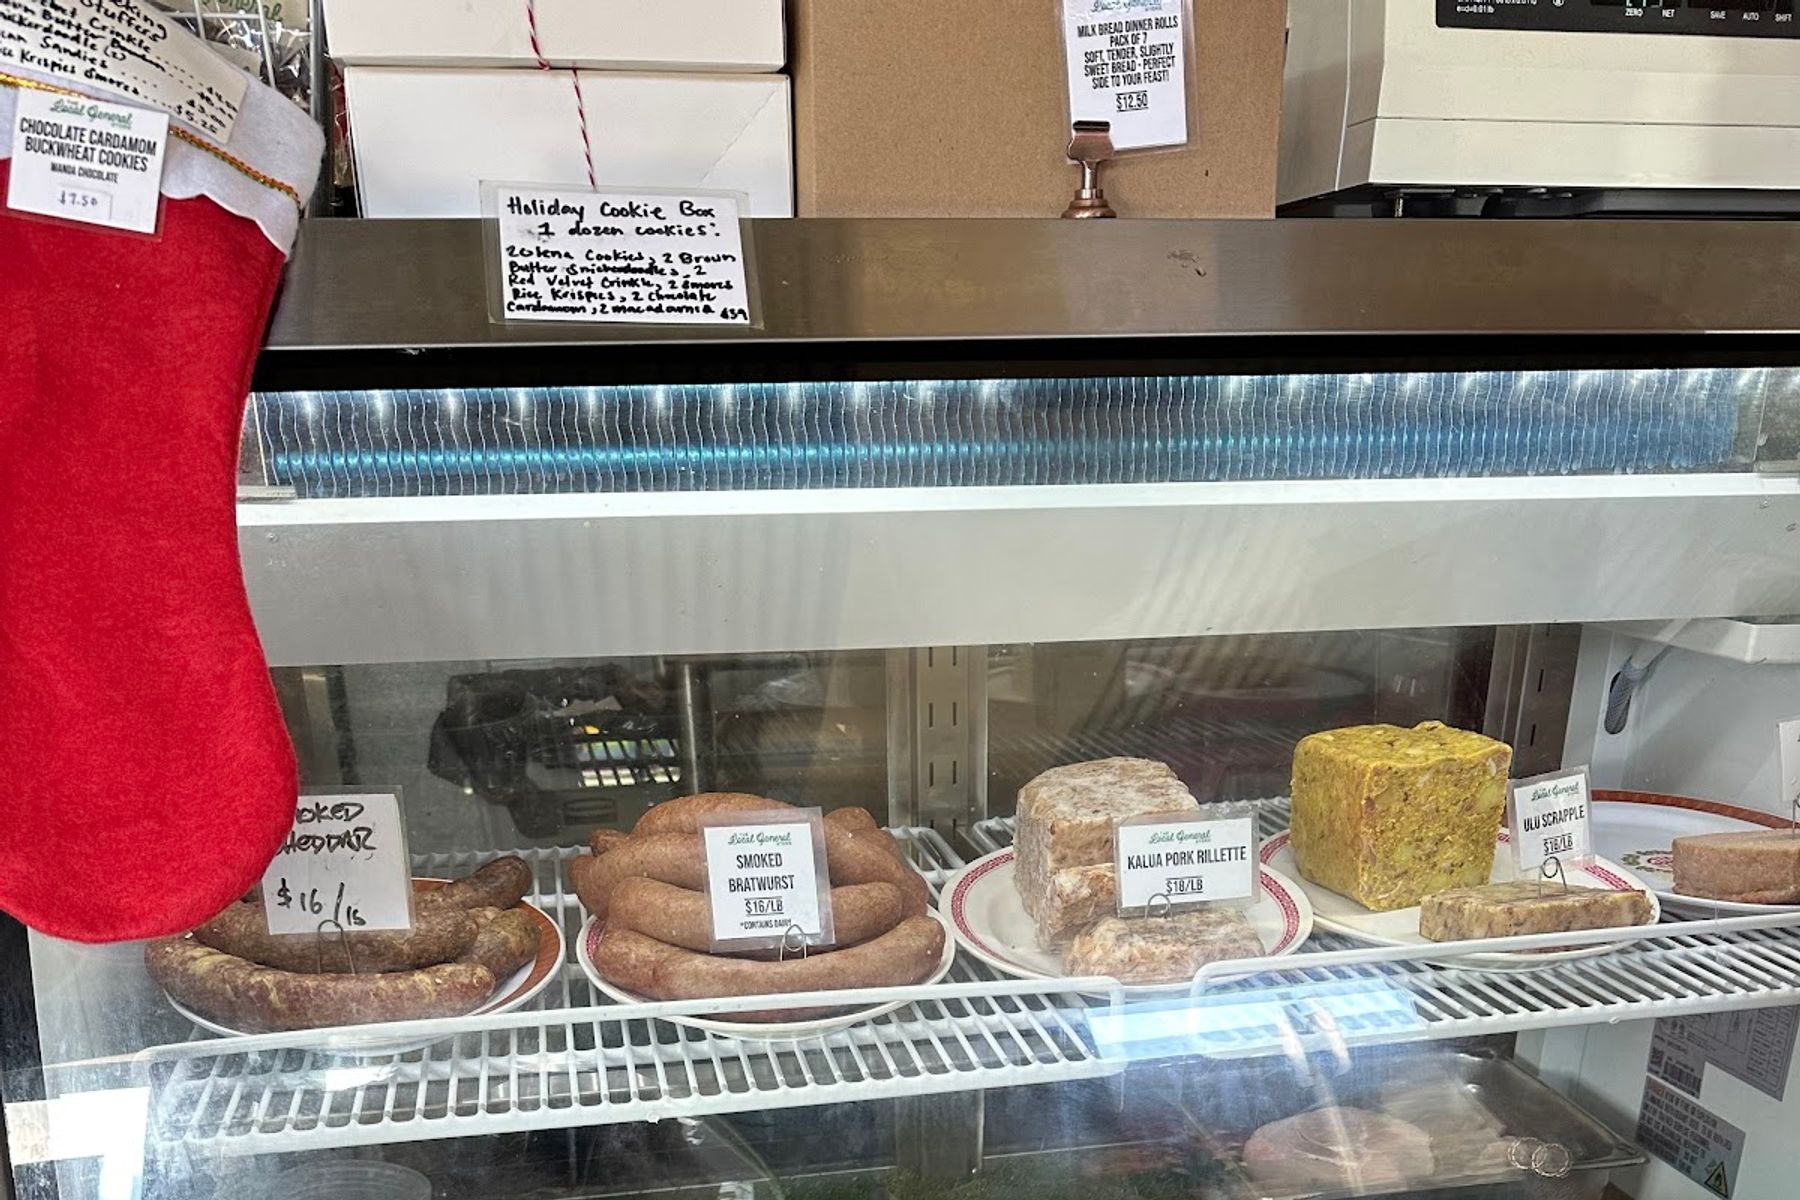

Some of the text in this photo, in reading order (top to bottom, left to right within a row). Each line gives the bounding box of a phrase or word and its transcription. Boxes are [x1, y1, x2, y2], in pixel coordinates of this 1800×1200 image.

[1625, 8, 1792, 22] ZERO NET SAVE AUTO SHIFT
[1077, 15, 1178, 37] MILK BREAD DINNER ROLLS
[1110, 32, 1147, 47] PACK OF 7
[40, 36, 108, 69] Sandies
[1139, 43, 1174, 58] SLIGHTLY
[1084, 63, 1109, 77] SWEET
[1111, 60, 1136, 74] BREAD
[1143, 56, 1175, 70] PERFECT
[1092, 77, 1109, 90] SIDE
[1111, 75, 1120, 87] TO
[1122, 73, 1142, 86] YOUR
[1116, 93, 1148, 109] $12.50
[50, 98, 132, 124] Local General
[20, 117, 157, 156] CHOCOLATE CARDAMOM
[25, 136, 148, 172] BUCKWHEAT COOKIES
[78, 168, 118, 184] CHOCOLATE
[507, 196, 715, 222] Holiday Cookie Box
[538, 222, 555, 236] 1
[569, 220, 624, 236] dozen
[662, 253, 673, 263] 2
[679, 252, 736, 264] Brown
[509, 261, 557, 275] Butter
[694, 265, 707, 275] 2
[509, 273, 535, 287] Red
[546, 275, 594, 289] Velvet
[668, 280, 678, 289] 2
[512, 288, 542, 300] Rice
[632, 291, 644, 301] 2
[296, 802, 364, 824] OKED
[1523, 805, 1585, 832] ULU SCRAPPLE
[728, 832, 791, 846] Local General
[1149, 829, 1211, 844] Local General
[736, 852, 783, 869] SMOKED
[1128, 846, 1247, 870] KALUA PORK RILLETTE
[728, 874, 795, 893] BRATWURST
[1166, 879, 1204, 894] $18/LB
[745, 900, 784, 914] $16/LB
